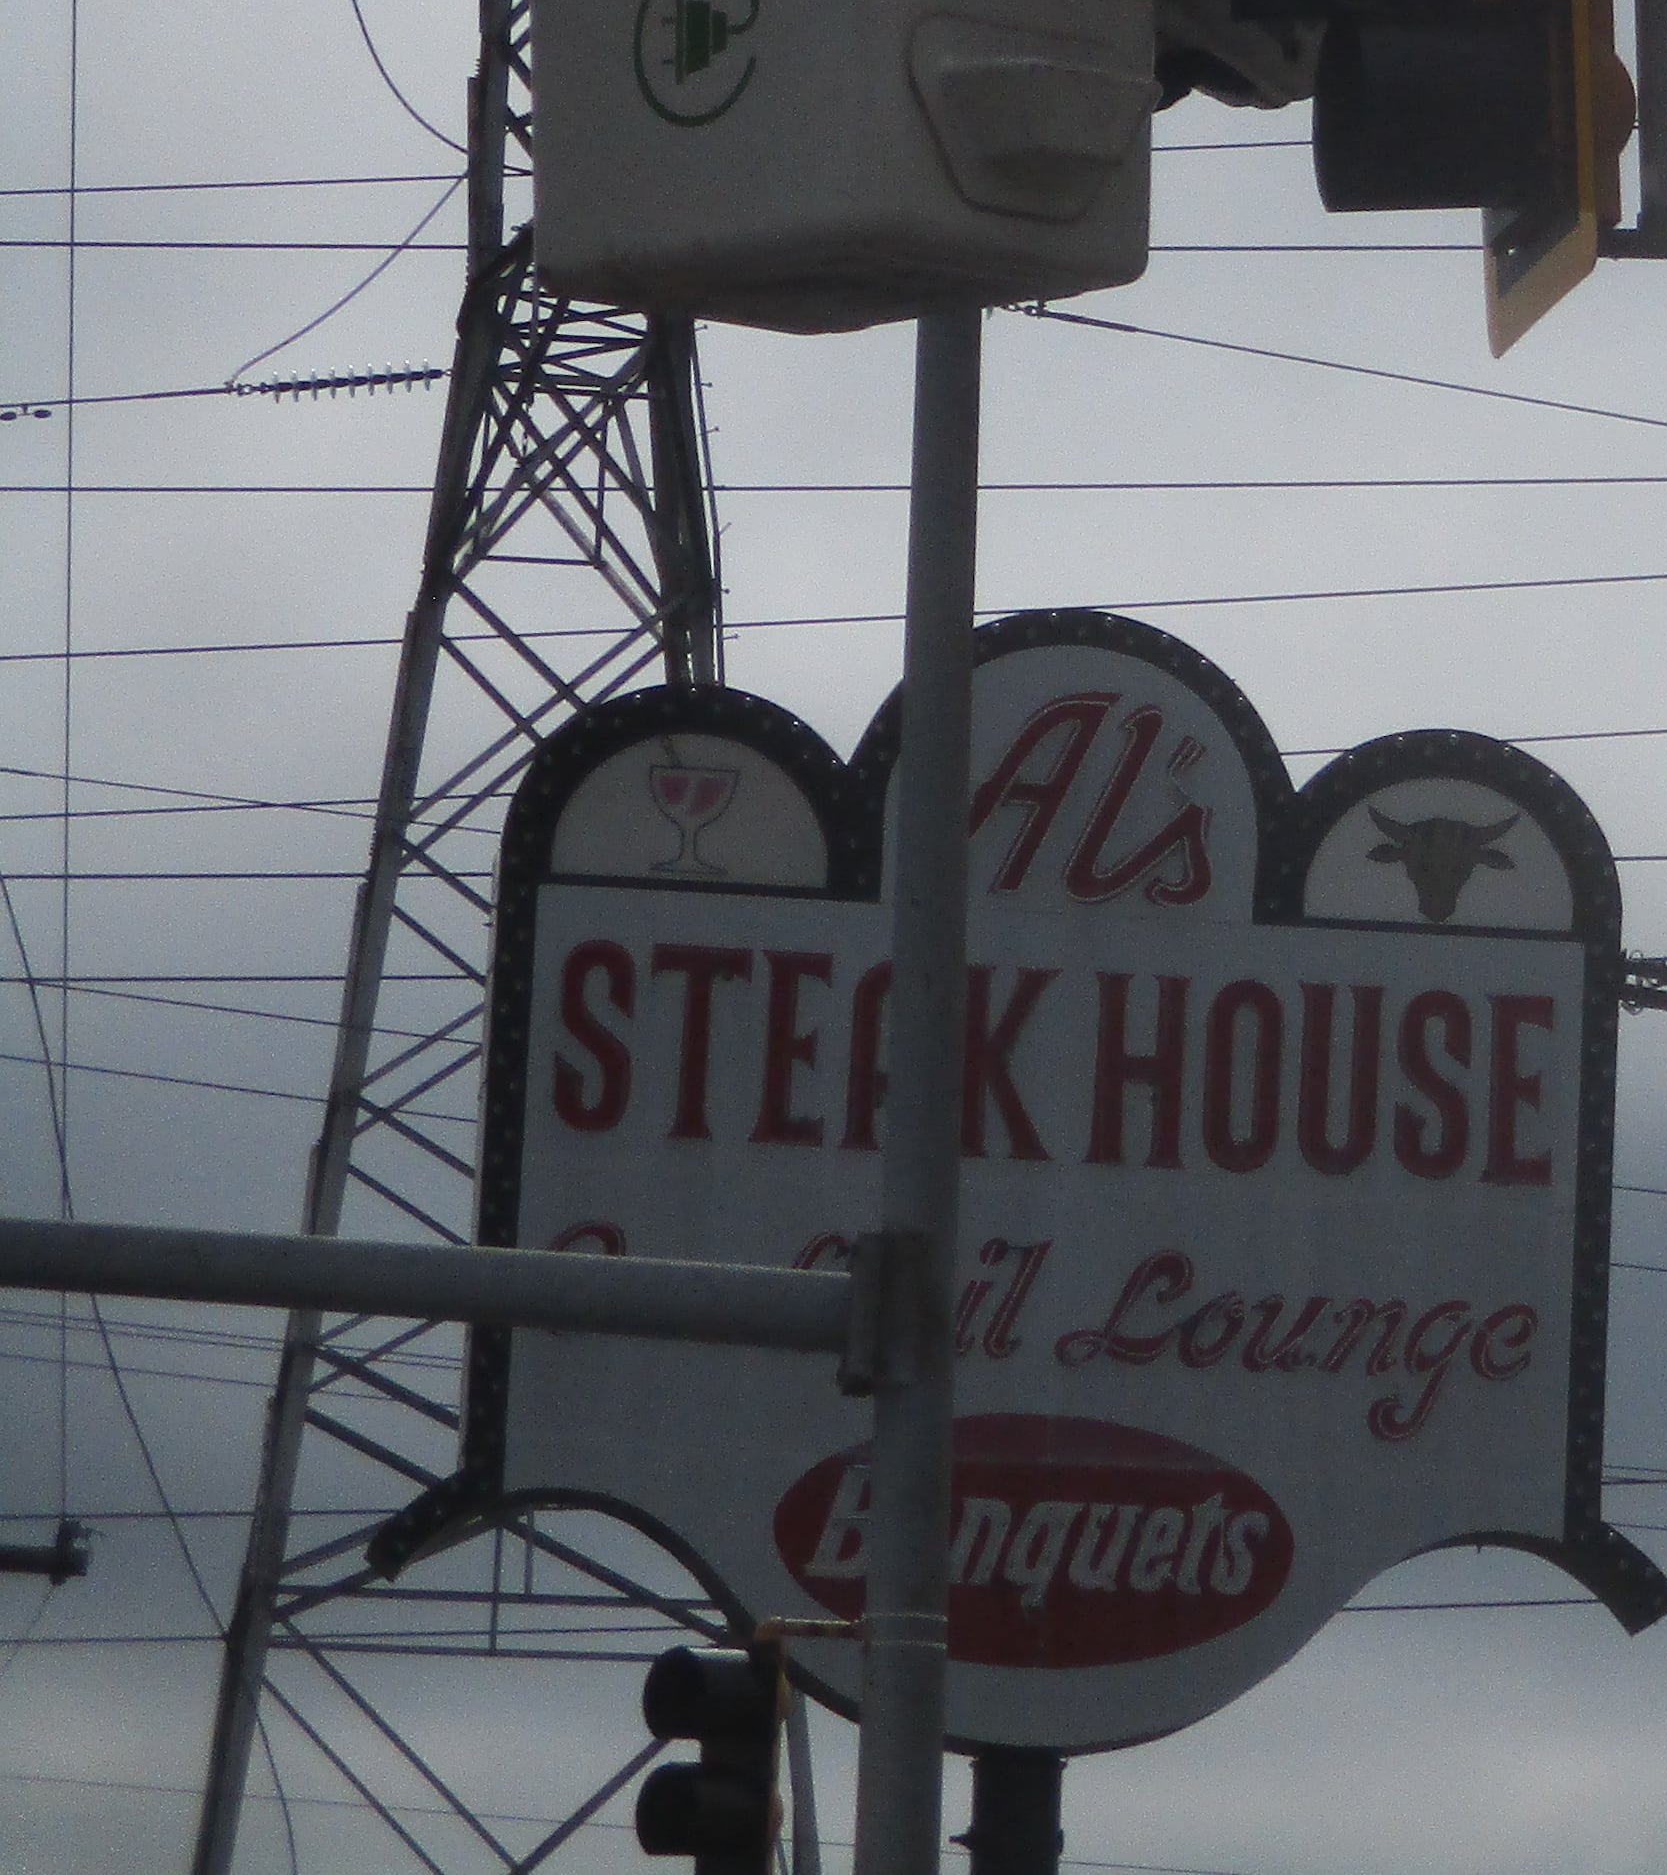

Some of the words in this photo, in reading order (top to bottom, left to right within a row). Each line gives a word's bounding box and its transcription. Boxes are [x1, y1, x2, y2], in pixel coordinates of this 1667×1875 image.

[970, 689, 1214, 908] Al's
[1084, 970, 1556, 1187] HOUSE
[1057, 1249, 1541, 1443] Lounge
[804, 1463, 1272, 1621] Bnquets
